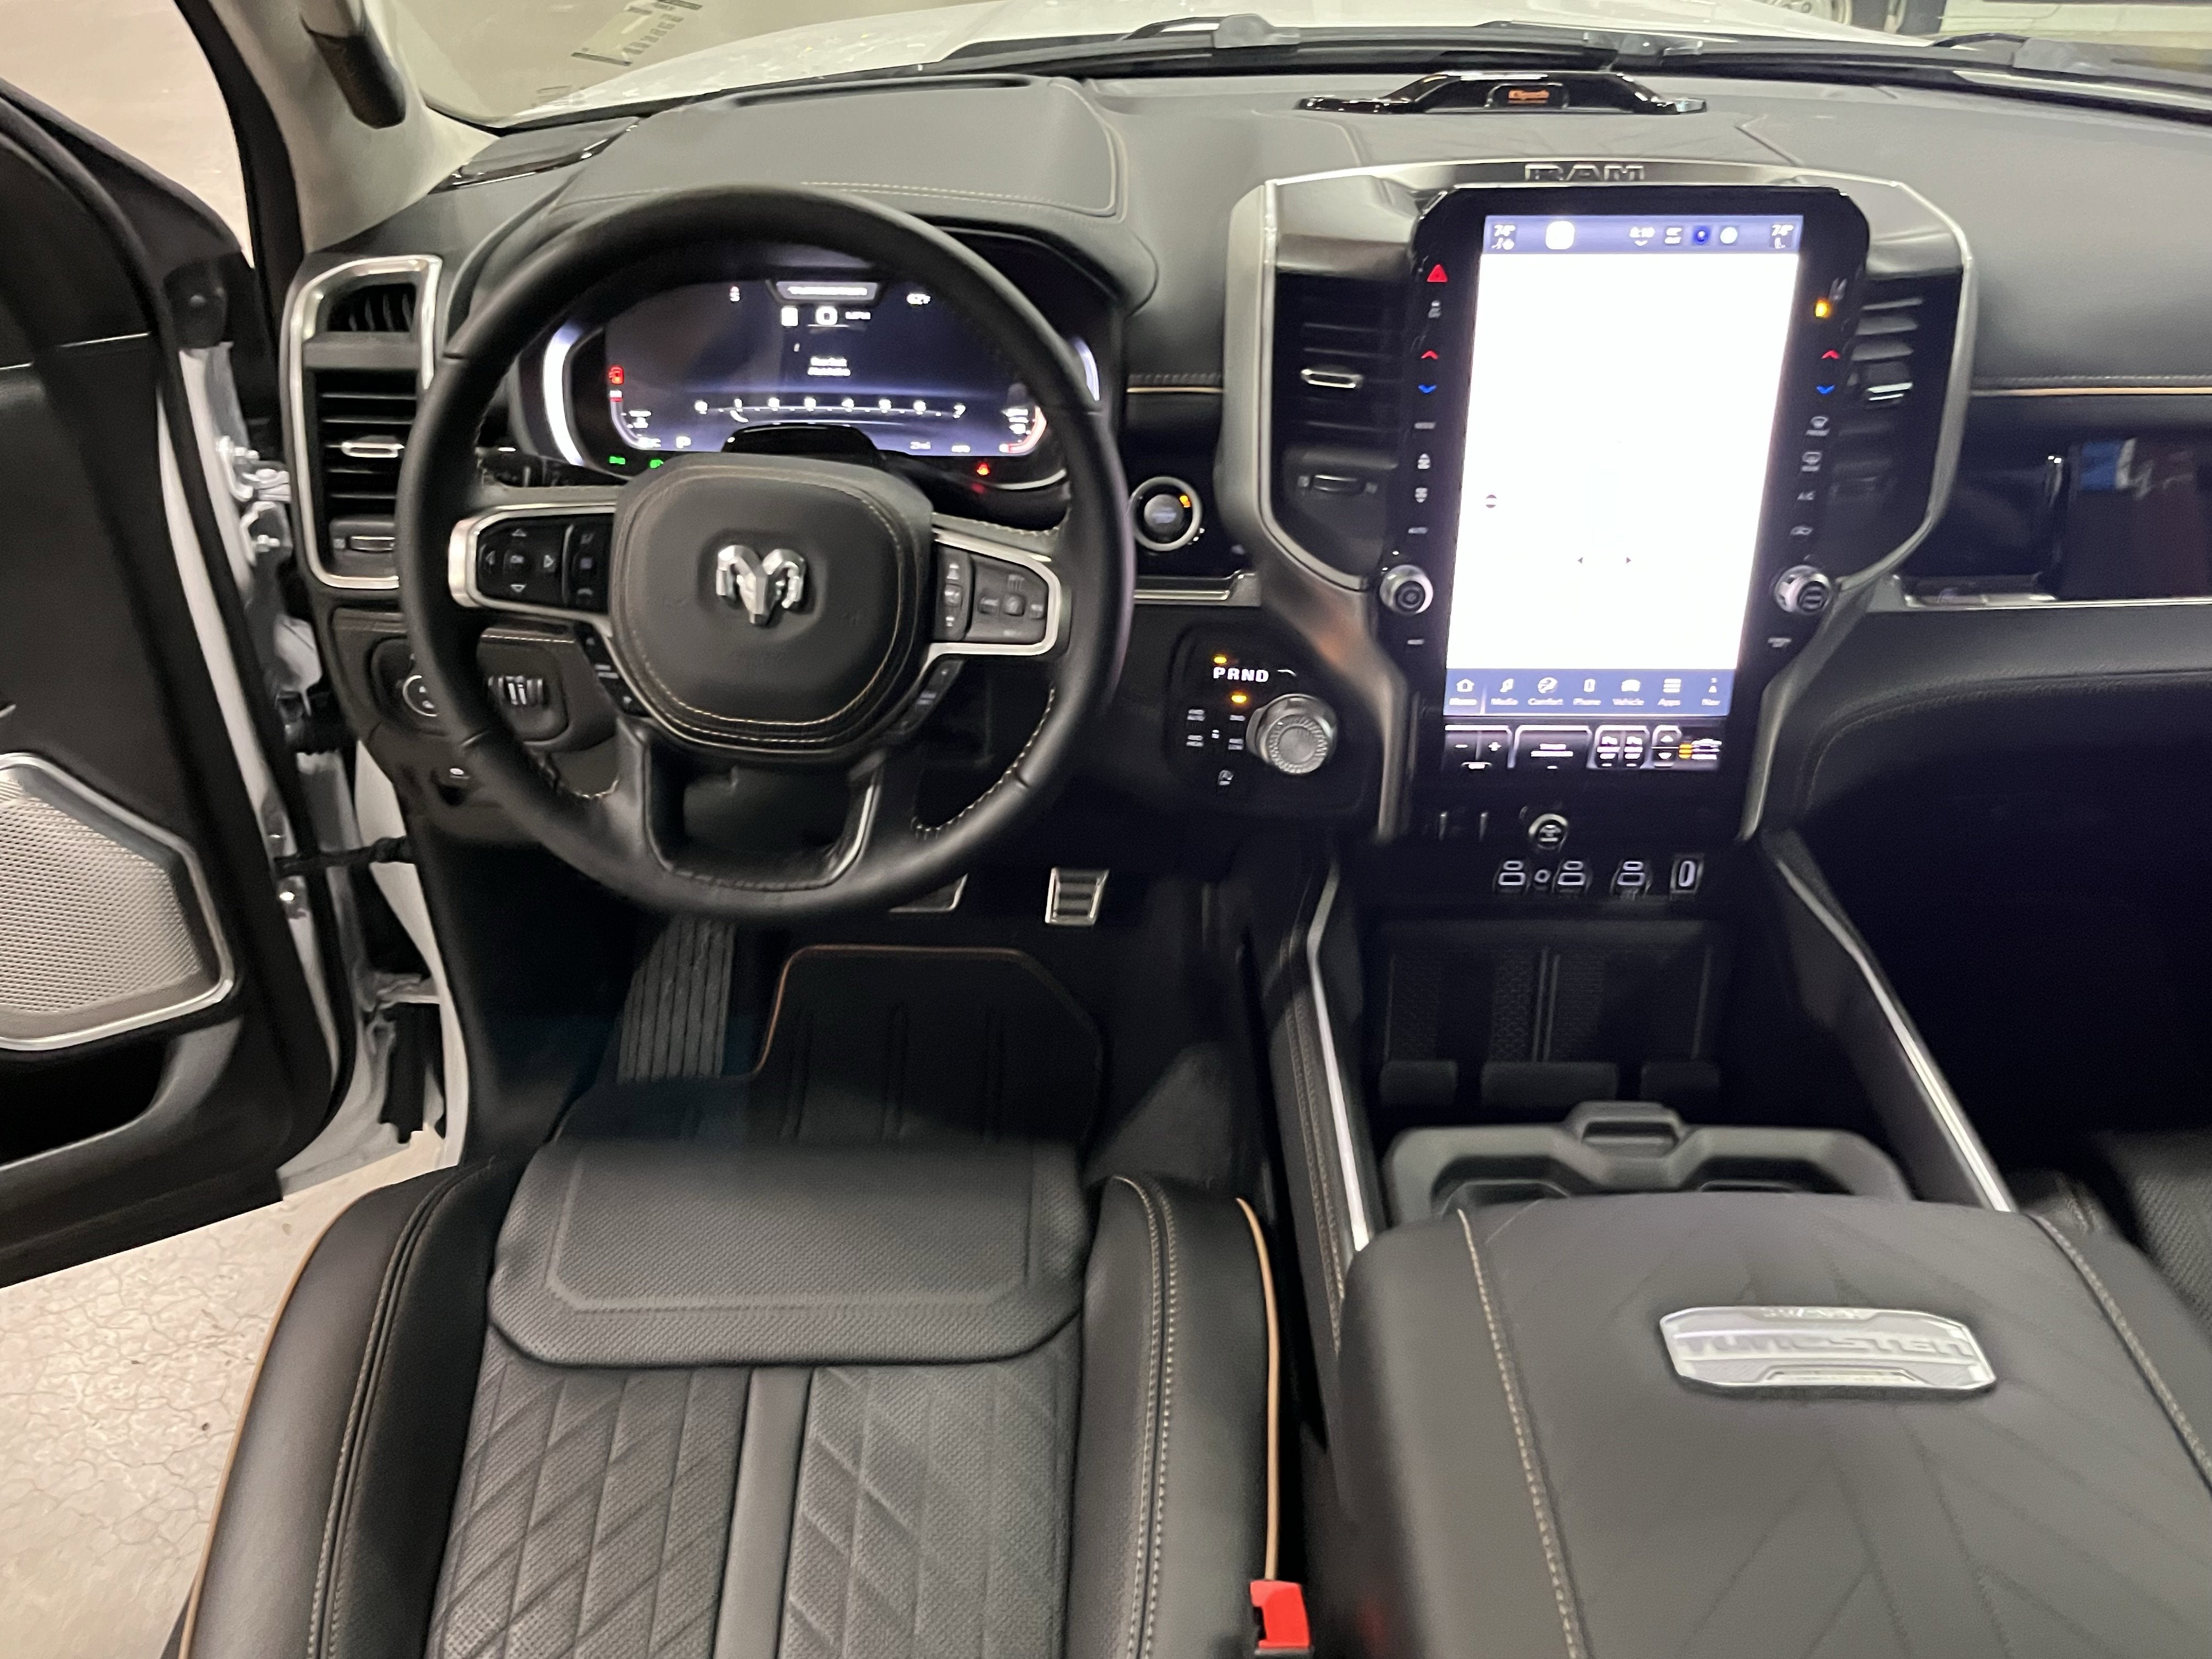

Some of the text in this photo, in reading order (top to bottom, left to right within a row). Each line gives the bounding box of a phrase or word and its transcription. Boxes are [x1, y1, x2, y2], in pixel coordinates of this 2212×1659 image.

[1525, 164, 1645, 181] RAM
[1212, 666, 1269, 683] PRND
[1679, 1333, 1977, 1358] TUNGSTEN
